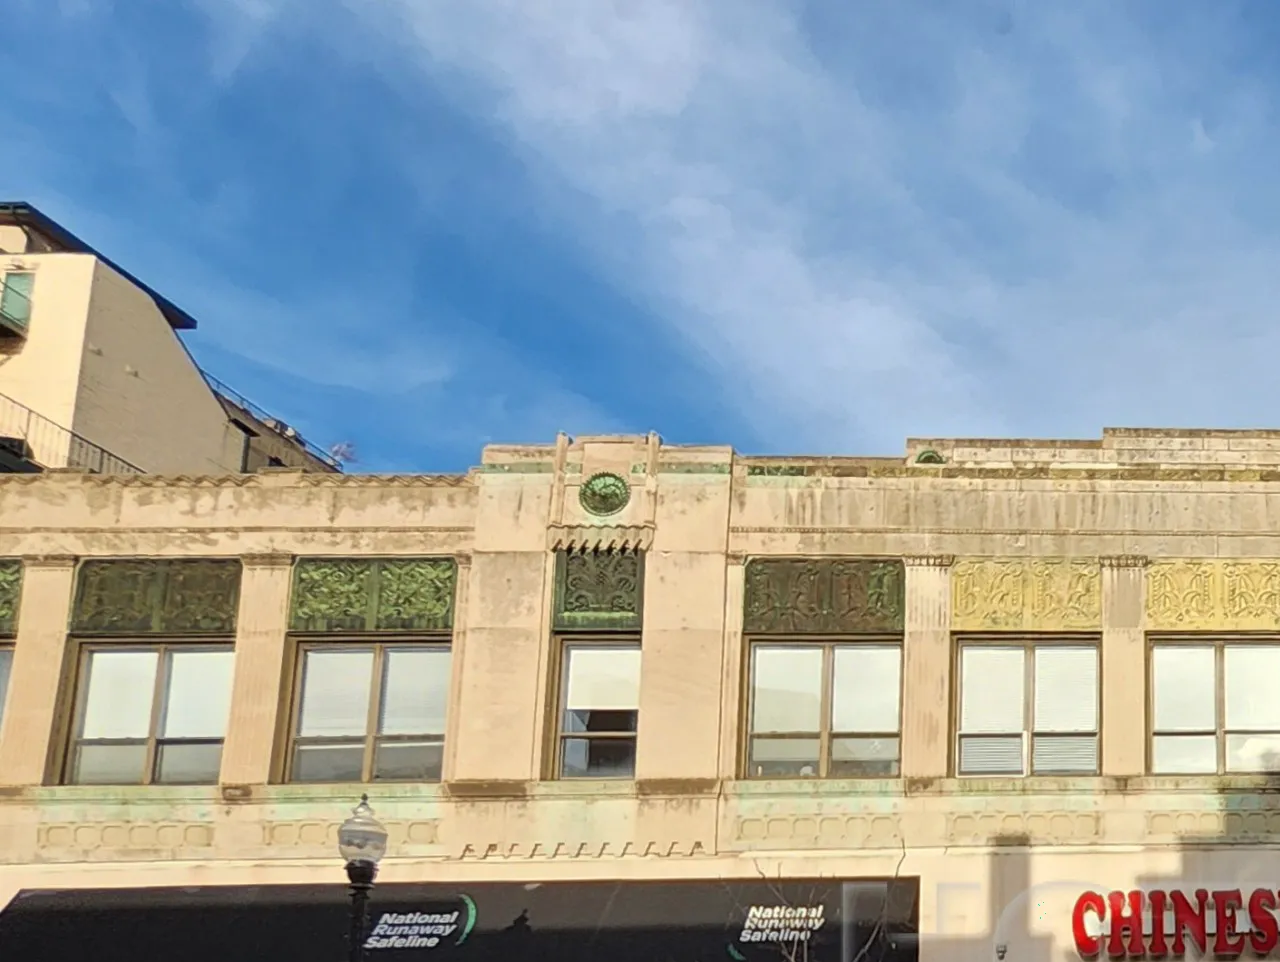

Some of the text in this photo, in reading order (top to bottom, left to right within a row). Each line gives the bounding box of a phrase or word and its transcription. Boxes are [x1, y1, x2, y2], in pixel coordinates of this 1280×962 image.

[379, 911, 459, 924] National
[748, 905, 824, 919] National
[371, 924, 458, 936] Runaway
[744, 917, 825, 930] Runaway
[362, 935, 440, 948] Safeline
[739, 929, 811, 942] Safeline
